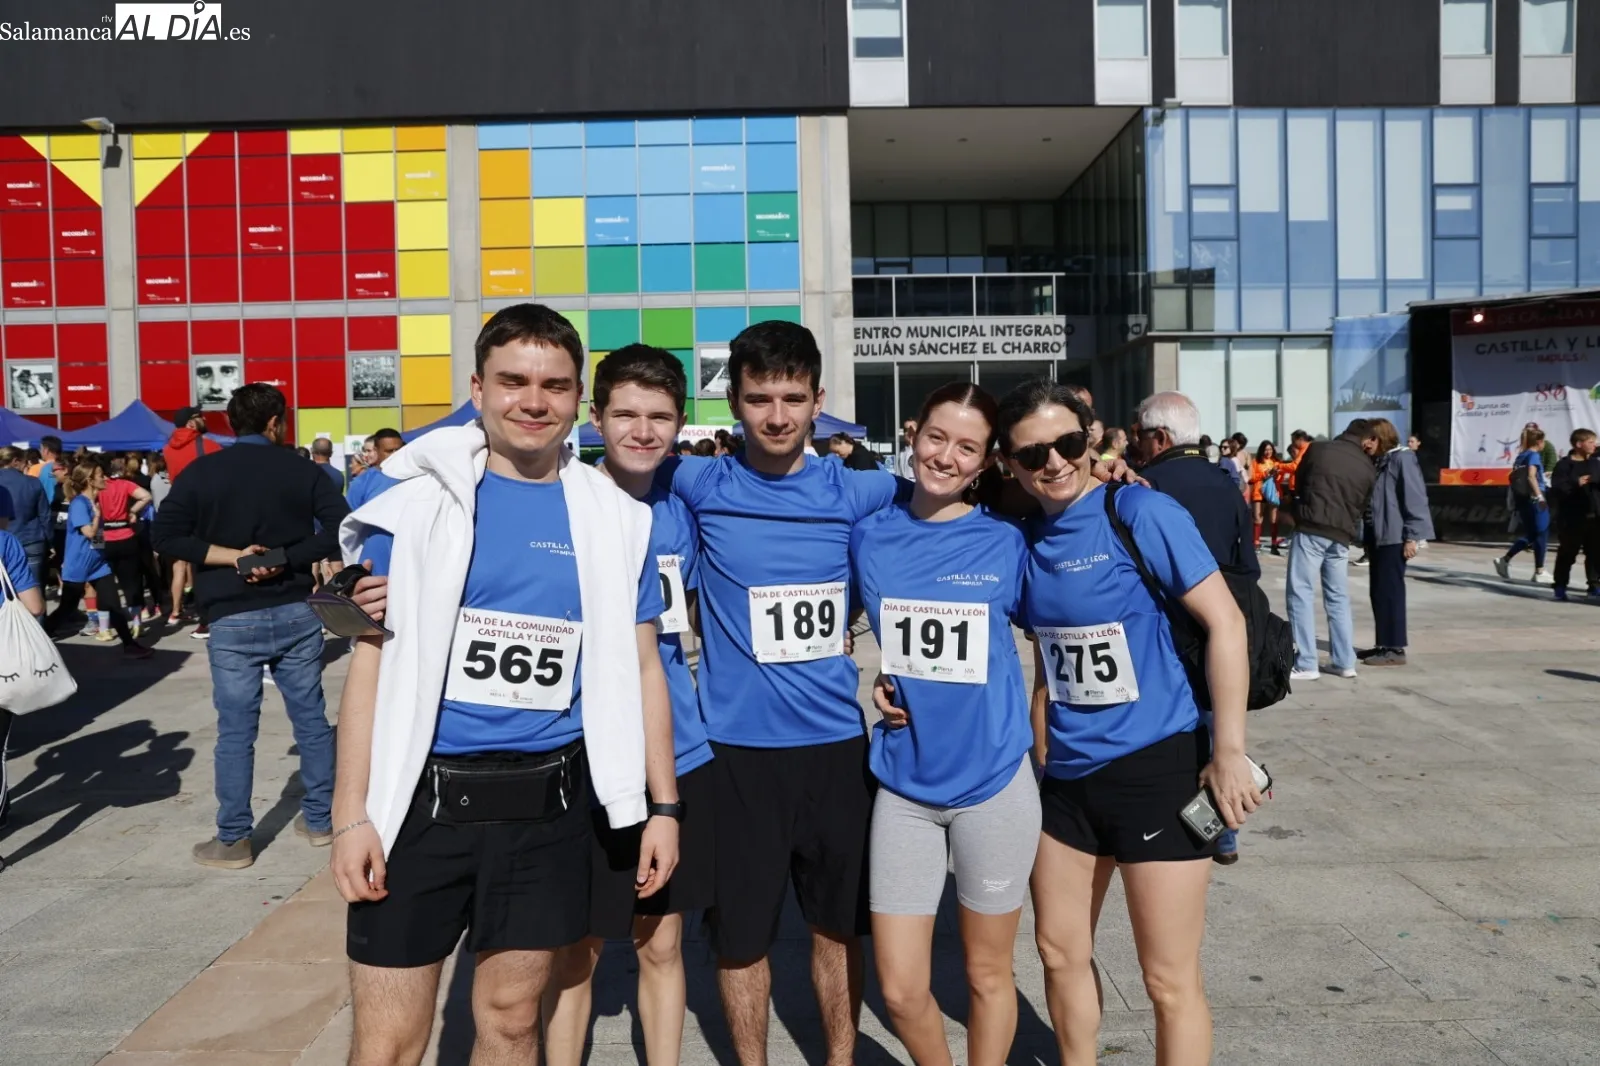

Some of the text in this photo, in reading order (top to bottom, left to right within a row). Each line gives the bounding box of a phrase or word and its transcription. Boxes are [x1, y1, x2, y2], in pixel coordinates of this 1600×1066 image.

[853, 322, 1076, 340] ENTRO MUNICIPAL INTEGRADO
[853, 341, 904, 357] JULIÁN
[909, 340, 976, 355] SÁNCHEZ
[983, 342, 997, 355] EL
[1475, 335, 1600, 355] CASTILLA Y L
[1472, 472, 1480, 481] 2
[529, 541, 569, 550] CASTILLA
[1090, 552, 1109, 563] LEÓN
[936, 572, 1000, 582] CASTILLA Y LEÓN
[752, 586, 844, 599] DÍA DE CASTILLA Y LEÓN
[884, 603, 898, 611] DÍA
[900, 605, 912, 613] DE
[913, 606, 953, 616] CASTILLA
[962, 607, 986, 617] LEÓN
[463, 614, 575, 635] DÍA DE LA COMUNIDAD
[765, 599, 836, 641] 189
[478, 628, 560, 645] CASTILLA Y LEÓN
[895, 617, 969, 661] 191
[1057, 631, 1088, 640] CASTILLA
[1089, 631, 1095, 639] Y
[1096, 627, 1121, 638] LEÓN
[463, 639, 564, 687] 565
[1050, 641, 1118, 684] 275
